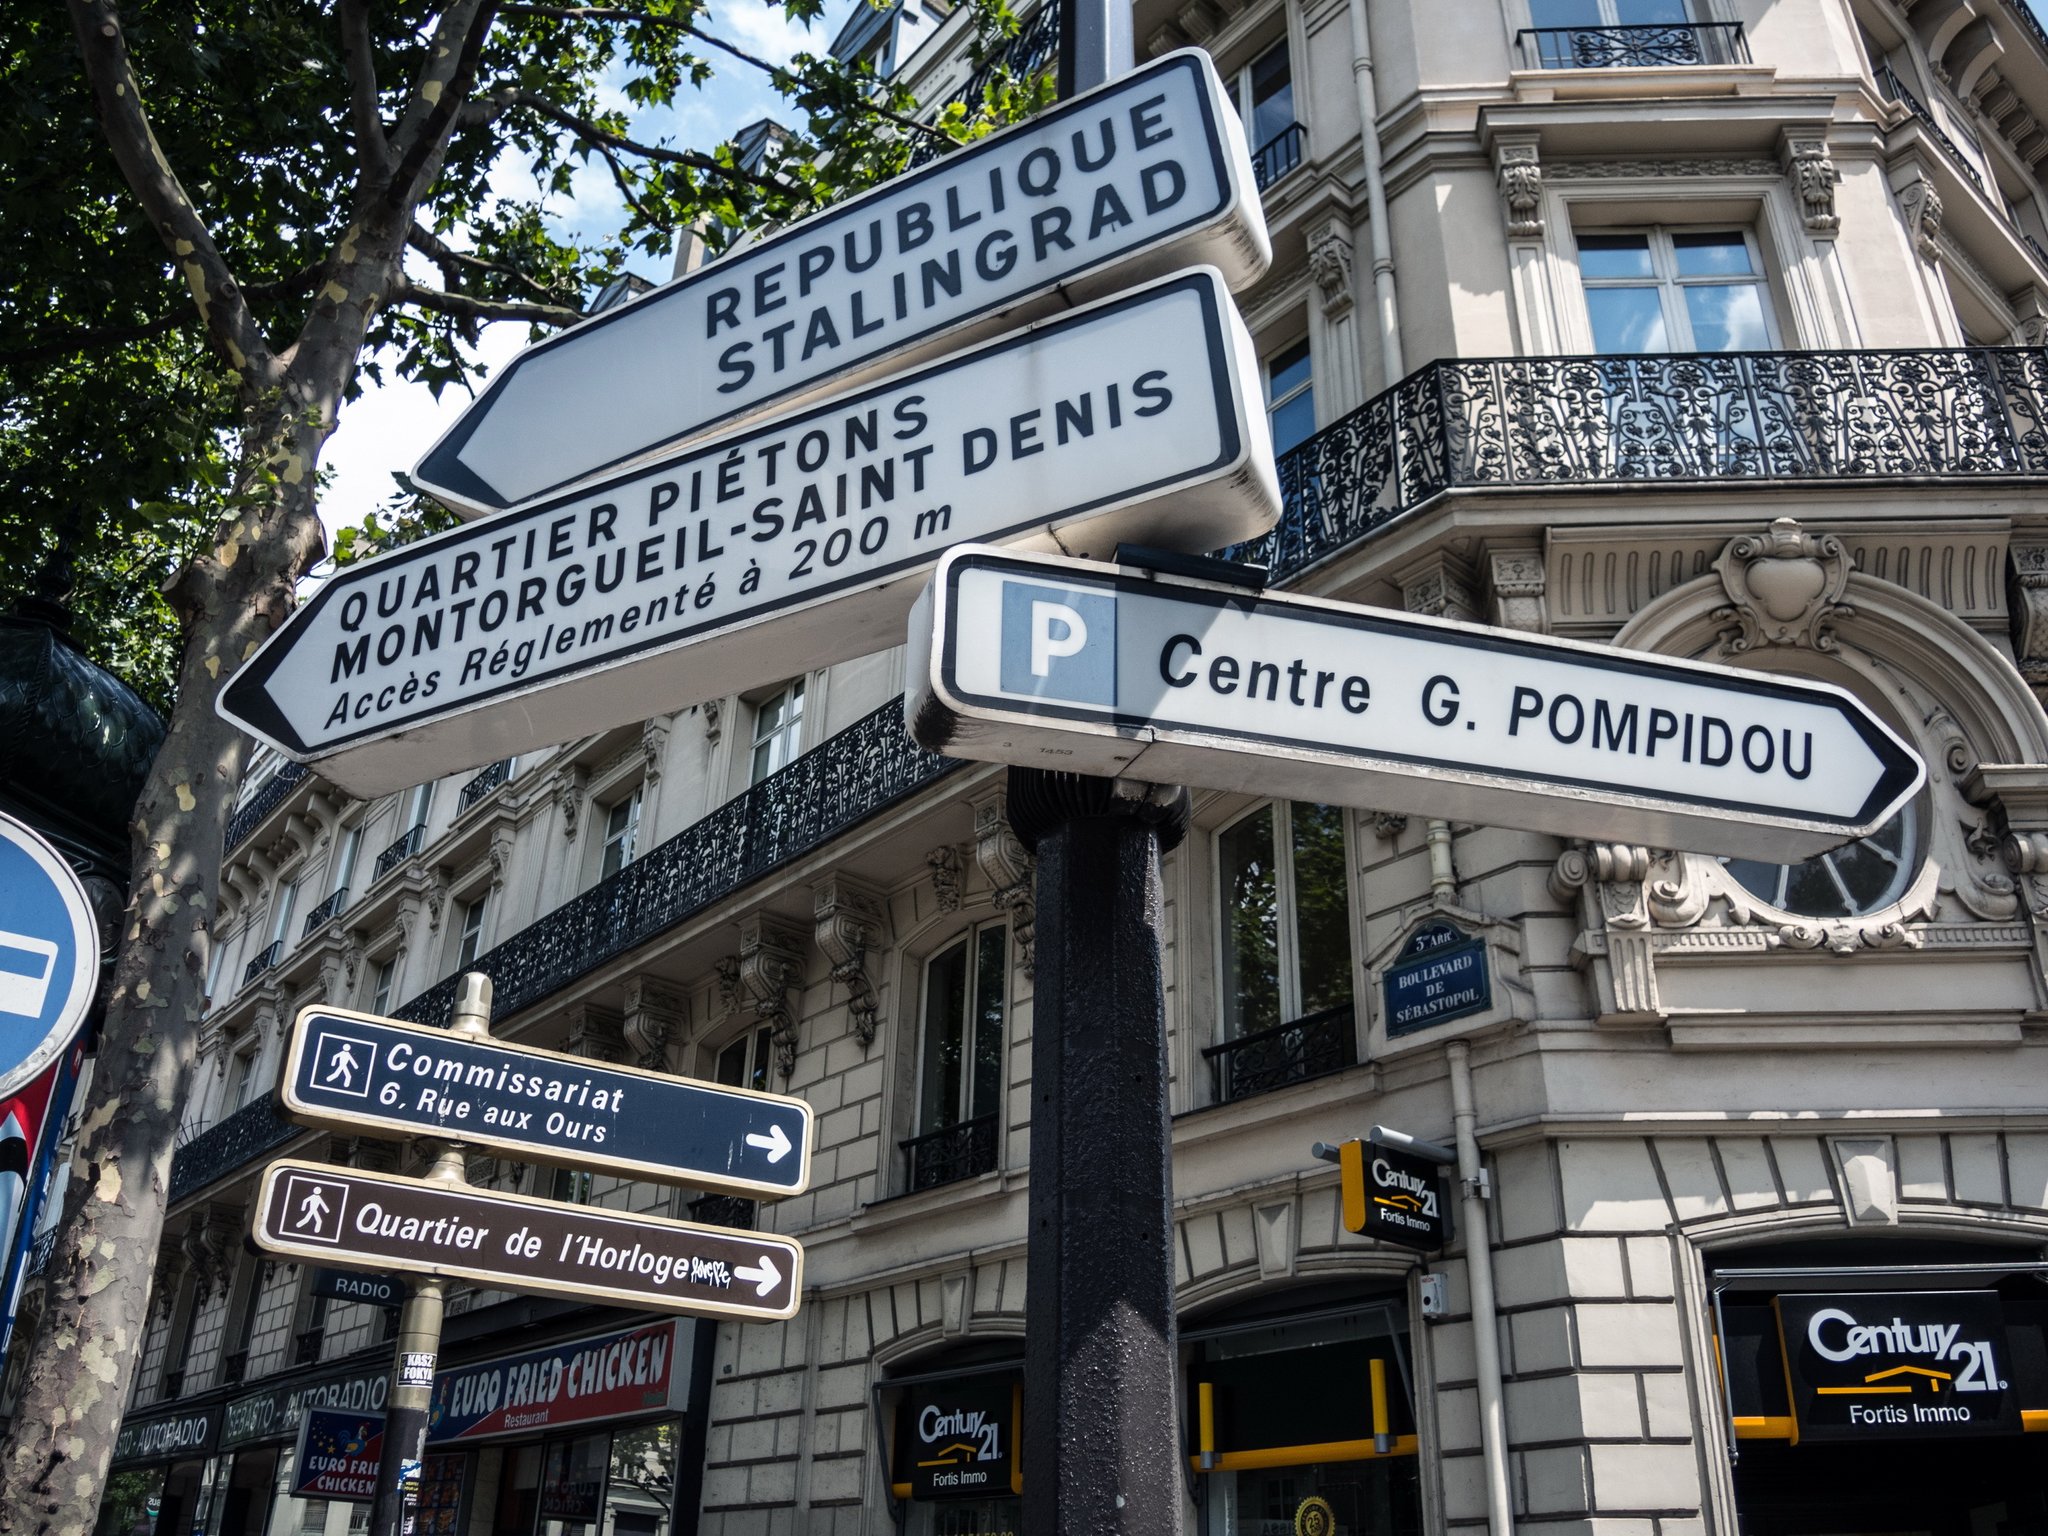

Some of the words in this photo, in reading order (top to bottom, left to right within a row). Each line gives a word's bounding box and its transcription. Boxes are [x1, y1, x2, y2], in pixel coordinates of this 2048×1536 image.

[706, 93, 1174, 339] REPUBLIQUE
[717, 159, 1188, 394] STALINGRAD
[330, 445, 934, 685] MONTORGUEIL-SAINT
[964, 370, 1174, 476] DENIS
[339, 503, 618, 633] QUARTIER
[648, 396, 929, 527] PIÉTONS
[323, 670, 440, 730] Accès
[459, 572, 717, 686] Réglementé
[739, 558, 761, 597] à
[789, 516, 890, 581] 200
[914, 503, 952, 540] m
[1031, 600, 1088, 677] P
[1159, 633, 1371, 714] Centre
[1421, 674, 1476, 731] G.
[1507, 685, 1813, 780] POMPIDOU
[1398, 955, 1472, 989] BOULEVARD
[1426, 981, 1445, 997] DE
[1396, 988, 1479, 1023] SÉBASTOPOL
[387, 1043, 624, 1112] Commissariat
[379, 1081, 408, 1110] 6,
[417, 1088, 470, 1119] Rue
[483, 1105, 533, 1130] aux
[546, 1112, 607, 1143] Ours
[1372, 1158, 1426, 1197] Century
[1421, 1190, 1438, 1218] 21
[356, 1202, 489, 1250] Quartier
[505, 1227, 543, 1258] de
[559, 1233, 690, 1284] l'Horloge
[1380, 1207, 1405, 1226] Fortis
[1406, 1214, 1431, 1231] Immo
[335, 1277, 391, 1299] RADIO
[450, 1369, 500, 1418] EURO
[503, 1357, 563, 1410] FRIED
[568, 1334, 668, 1399] CHICKEN
[1808, 1308, 1961, 1362] Century
[1949, 1341, 1999, 1392] 21
[138, 1416, 207, 1451] AUTORADIO
[227, 1399, 275, 1439] SEBASTO
[504, 1409, 549, 1428] Restaurant
[919, 1404, 986, 1443] Century
[977, 1423, 998, 1461] 21
[1850, 1404, 1907, 1424] Fortis
[1913, 1403, 1970, 1423] Immo
[309, 1456, 345, 1472] EURO
[317, 1476, 375, 1493] CHICKEN
[933, 1472, 958, 1487] Fortis
[961, 1471, 987, 1486] Immo
